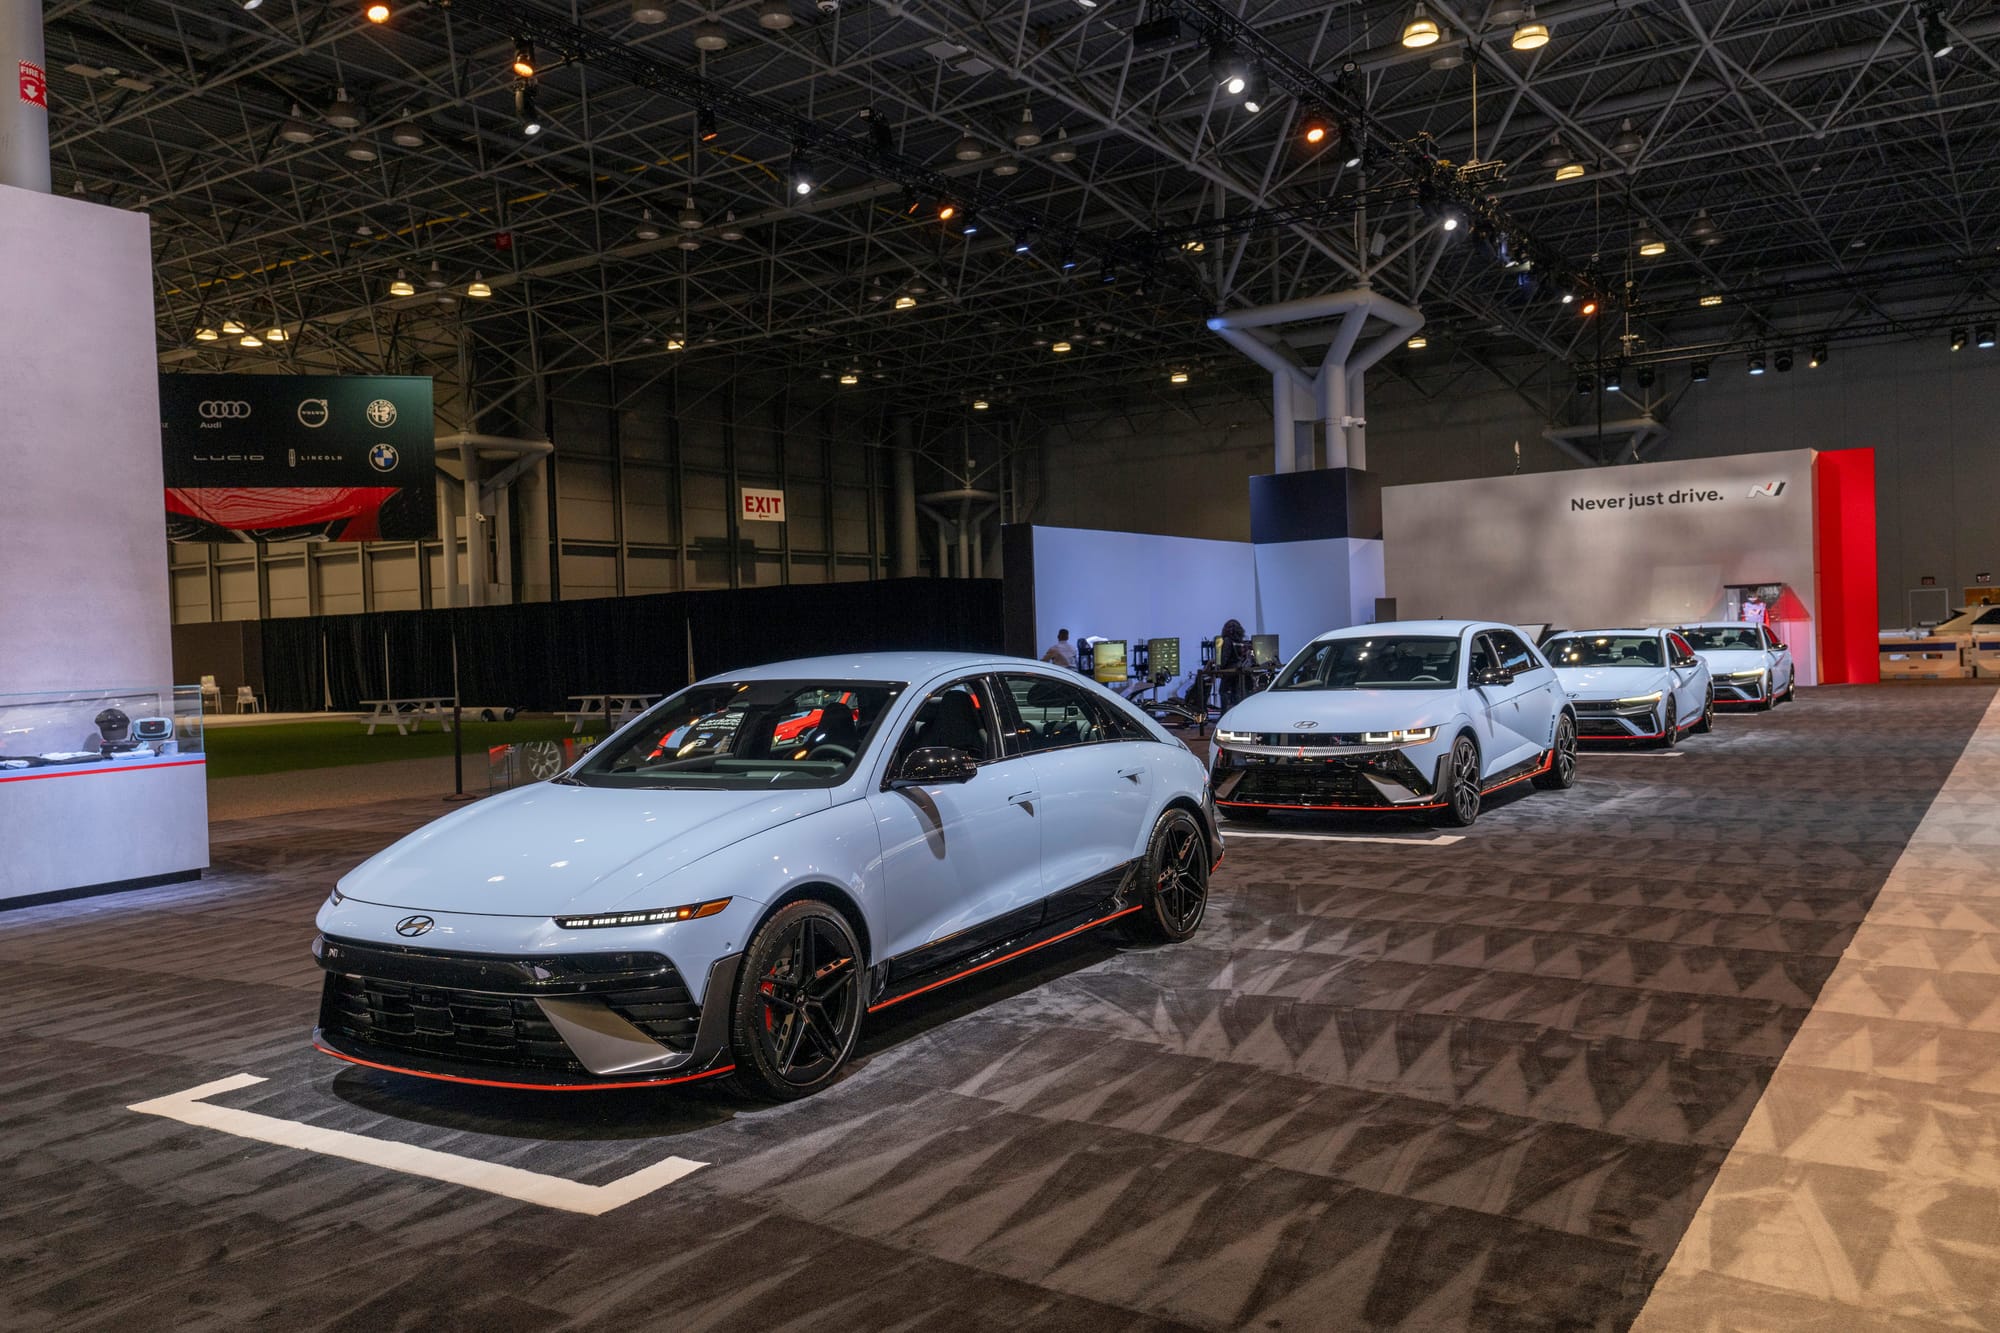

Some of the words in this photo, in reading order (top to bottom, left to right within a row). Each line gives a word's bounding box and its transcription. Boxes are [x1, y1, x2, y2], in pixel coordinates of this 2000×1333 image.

[744, 495, 782, 514] EXIT
[1571, 497, 1626, 511] Never
[1628, 492, 1665, 510] just
[1668, 488, 1724, 504] drive.
